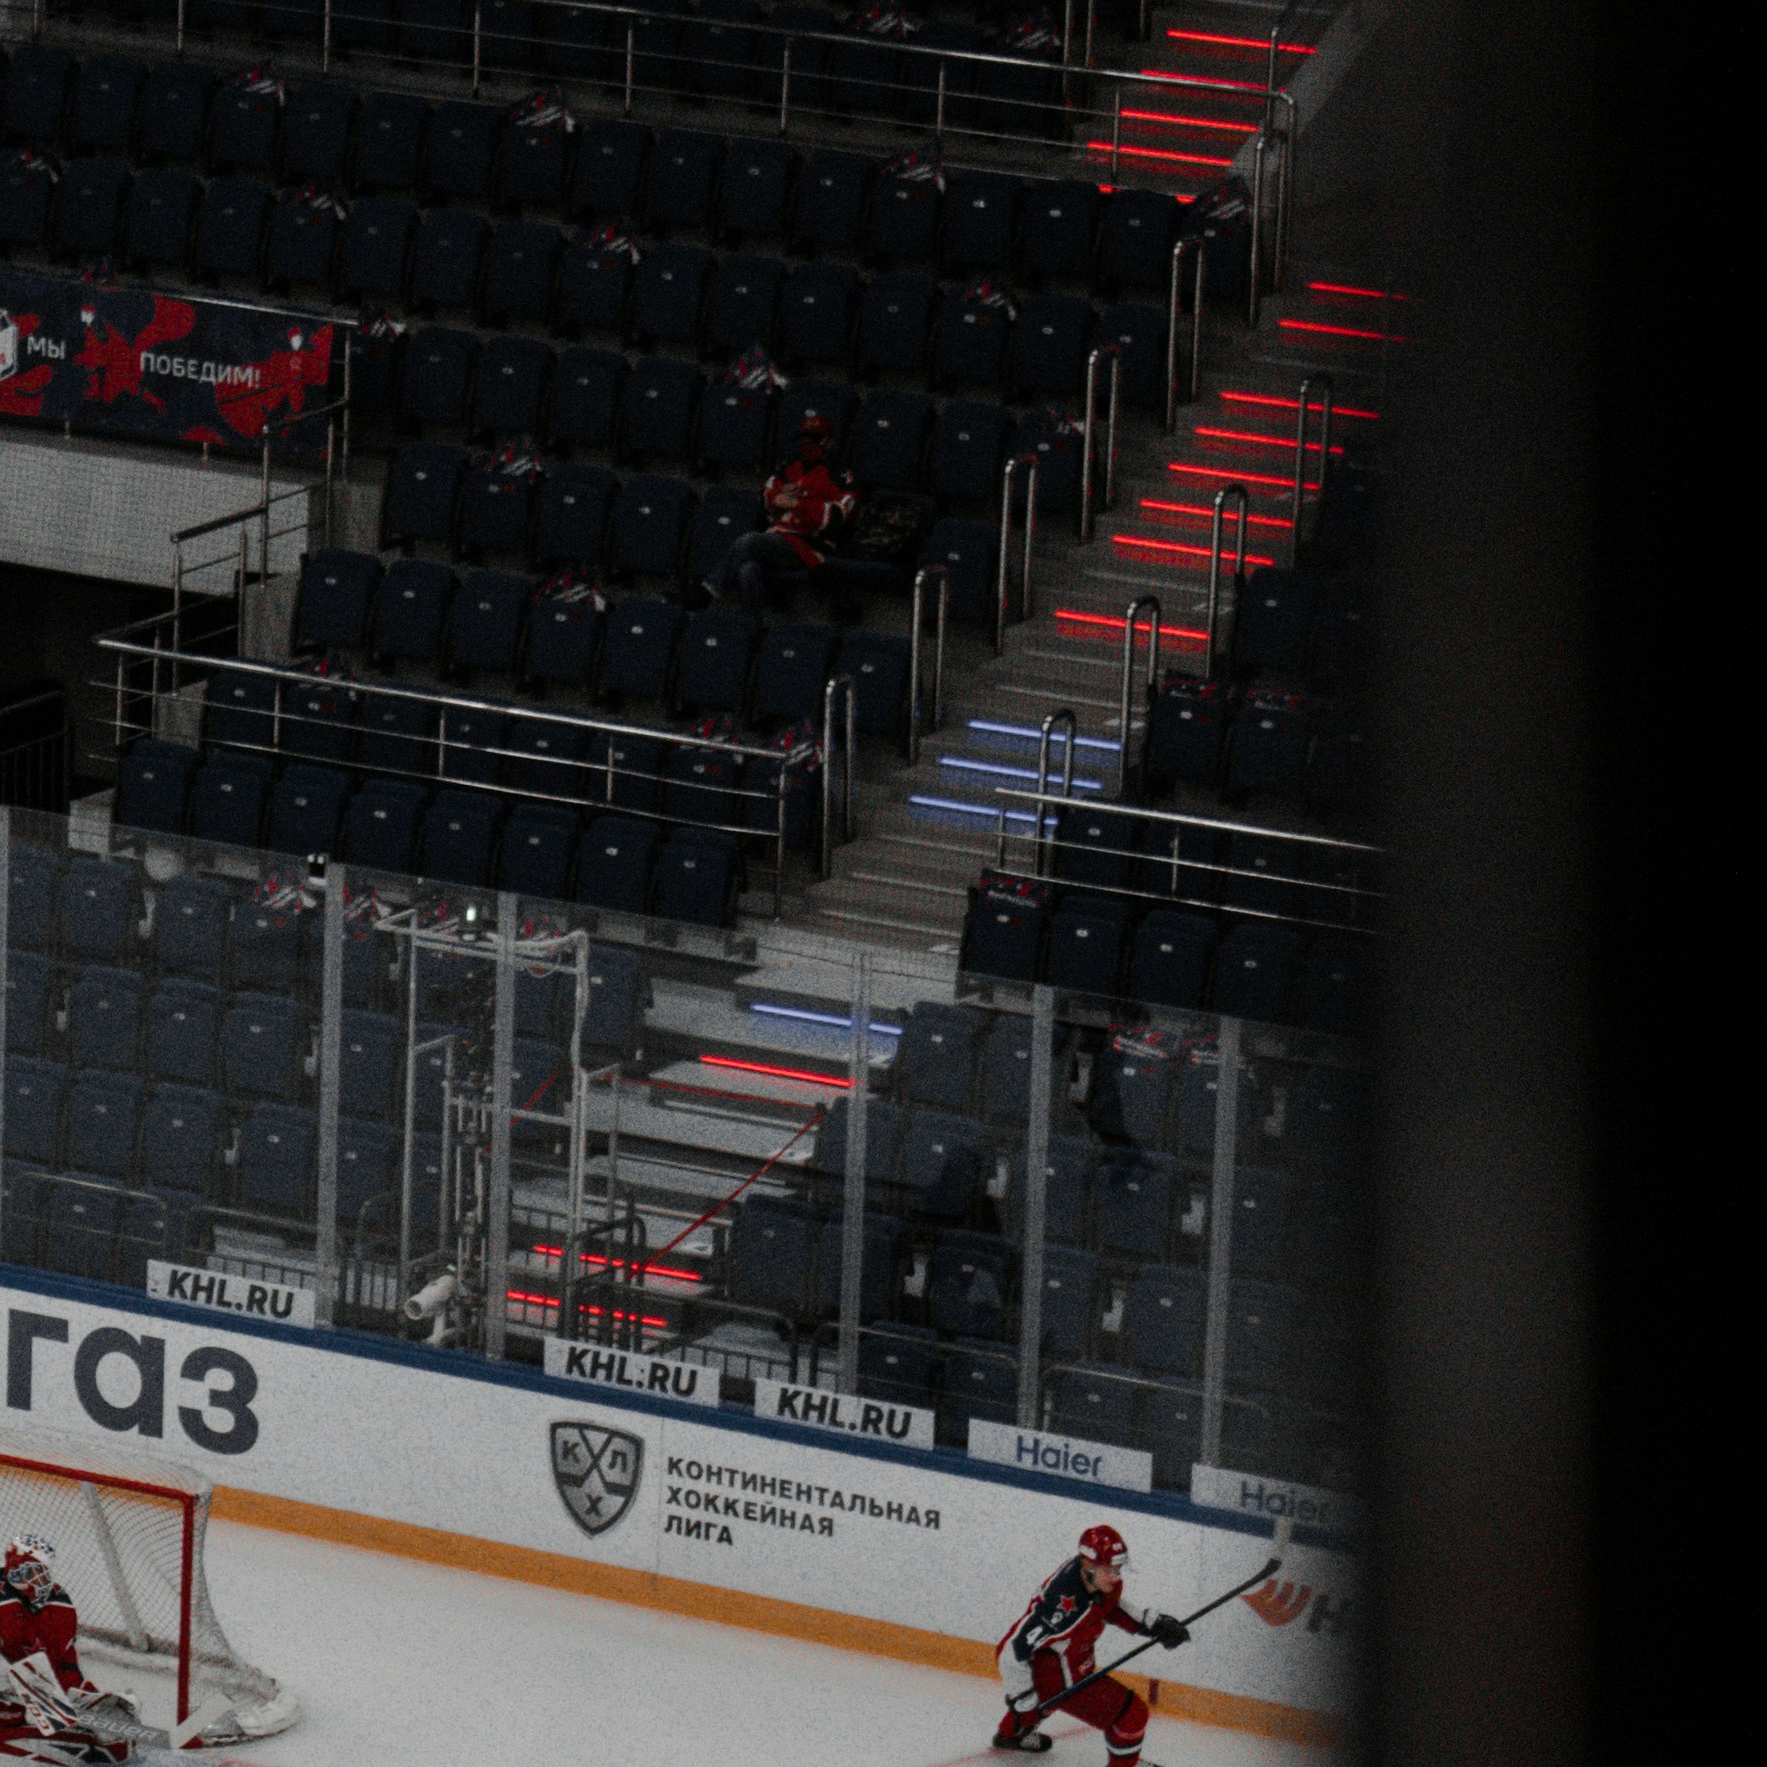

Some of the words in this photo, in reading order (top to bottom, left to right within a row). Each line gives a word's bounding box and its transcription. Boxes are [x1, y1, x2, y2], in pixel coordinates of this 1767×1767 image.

[27, 335, 66, 360] МЫ
[139, 350, 261, 389] ПОБЕДИМ!
[168, 1269, 295, 1319] KHL.RU
[566, 1346, 699, 1397] KHL.RU
[778, 1387, 912, 1440] KHL.RU
[562, 1440, 581, 1465] К
[608, 1448, 629, 1474] Л
[1016, 1434, 1103, 1478] Haier
[585, 1492, 602, 1518] Х
[666, 1485, 835, 1537] ХОККЕЙНАЯ
[667, 1456, 941, 1530] КОНТИНЕНТАЛЬНАЯ
[1240, 1480, 1332, 1523] Haier
[665, 1515, 734, 1545] ЛИГА
